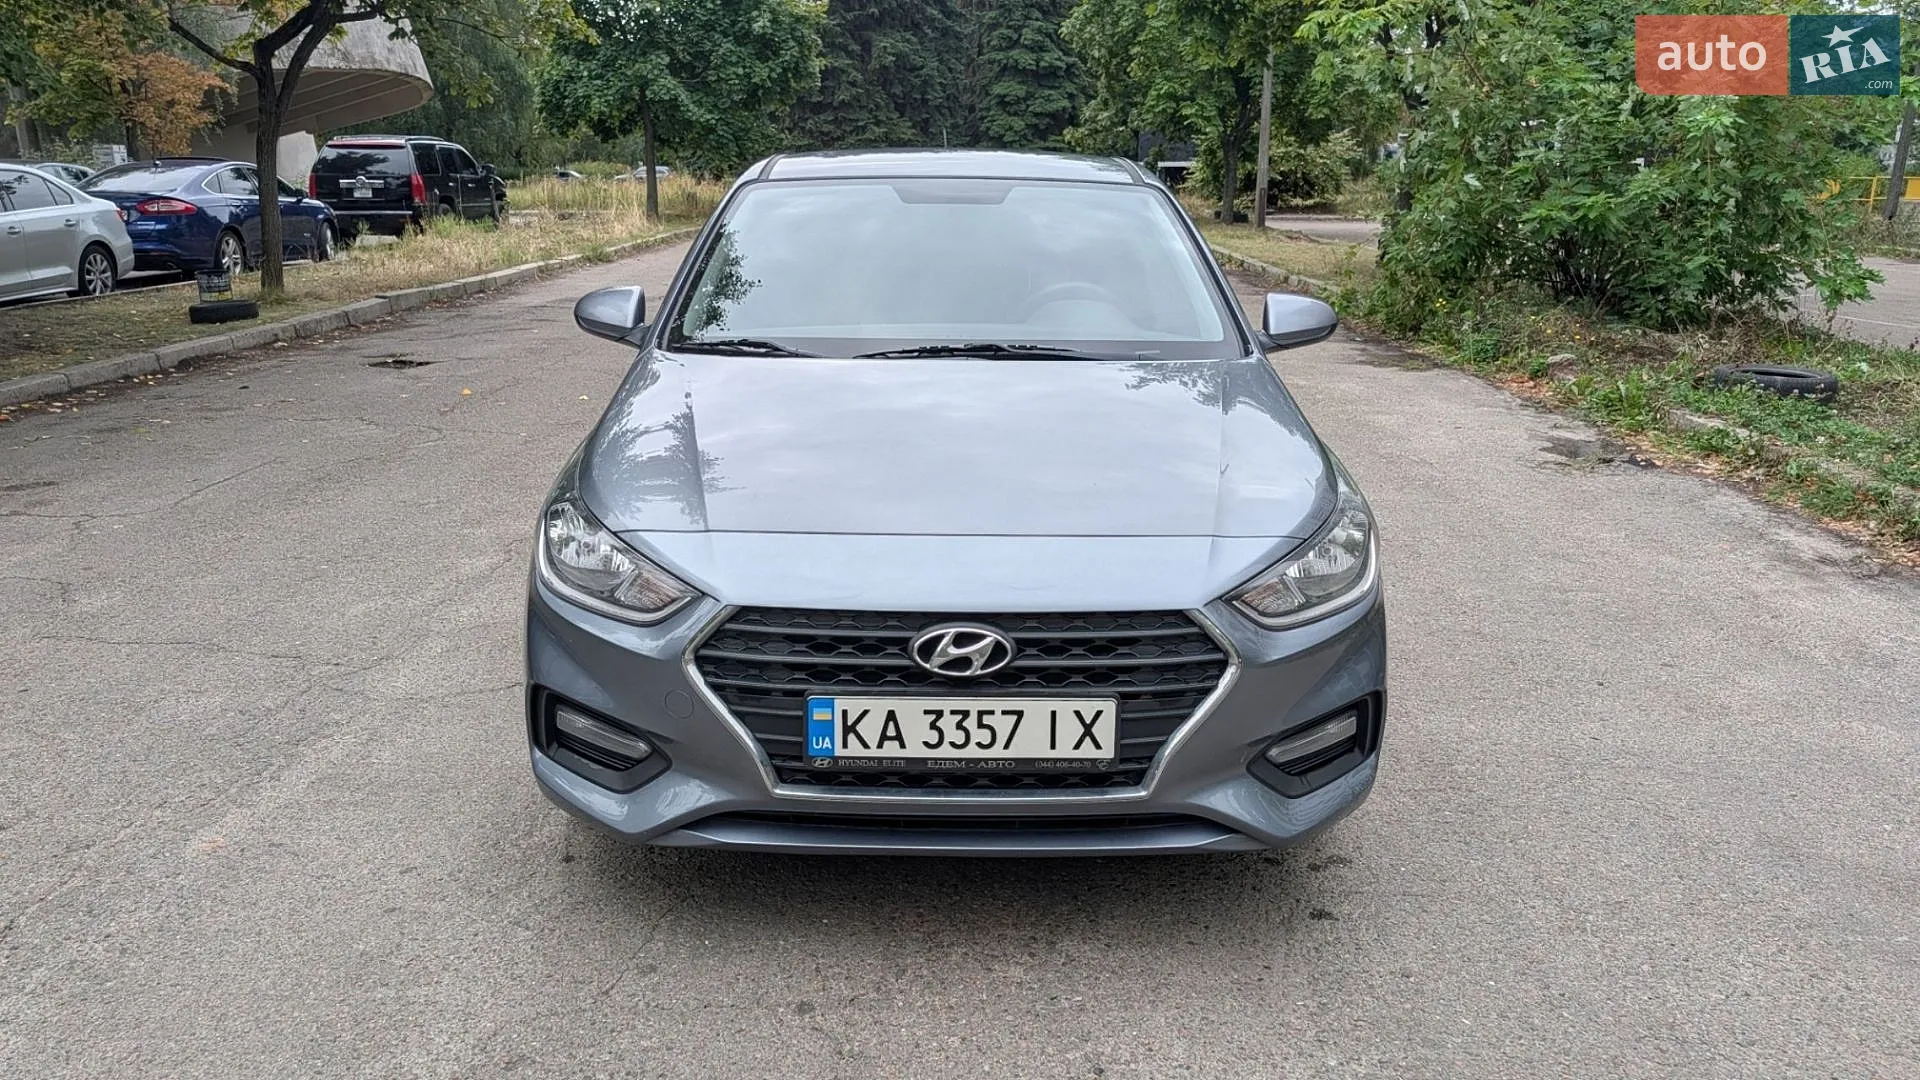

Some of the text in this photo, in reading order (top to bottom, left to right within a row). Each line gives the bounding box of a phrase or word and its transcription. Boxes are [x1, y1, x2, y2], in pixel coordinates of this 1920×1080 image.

[841, 709, 907, 750] KA
[922, 709, 1025, 750] 3357
[812, 736, 832, 749] UA
[838, 759, 878, 767] HYUNDAI
[927, 760, 966, 768] ЕДЕМ
[977, 760, 1015, 769] АВТО
